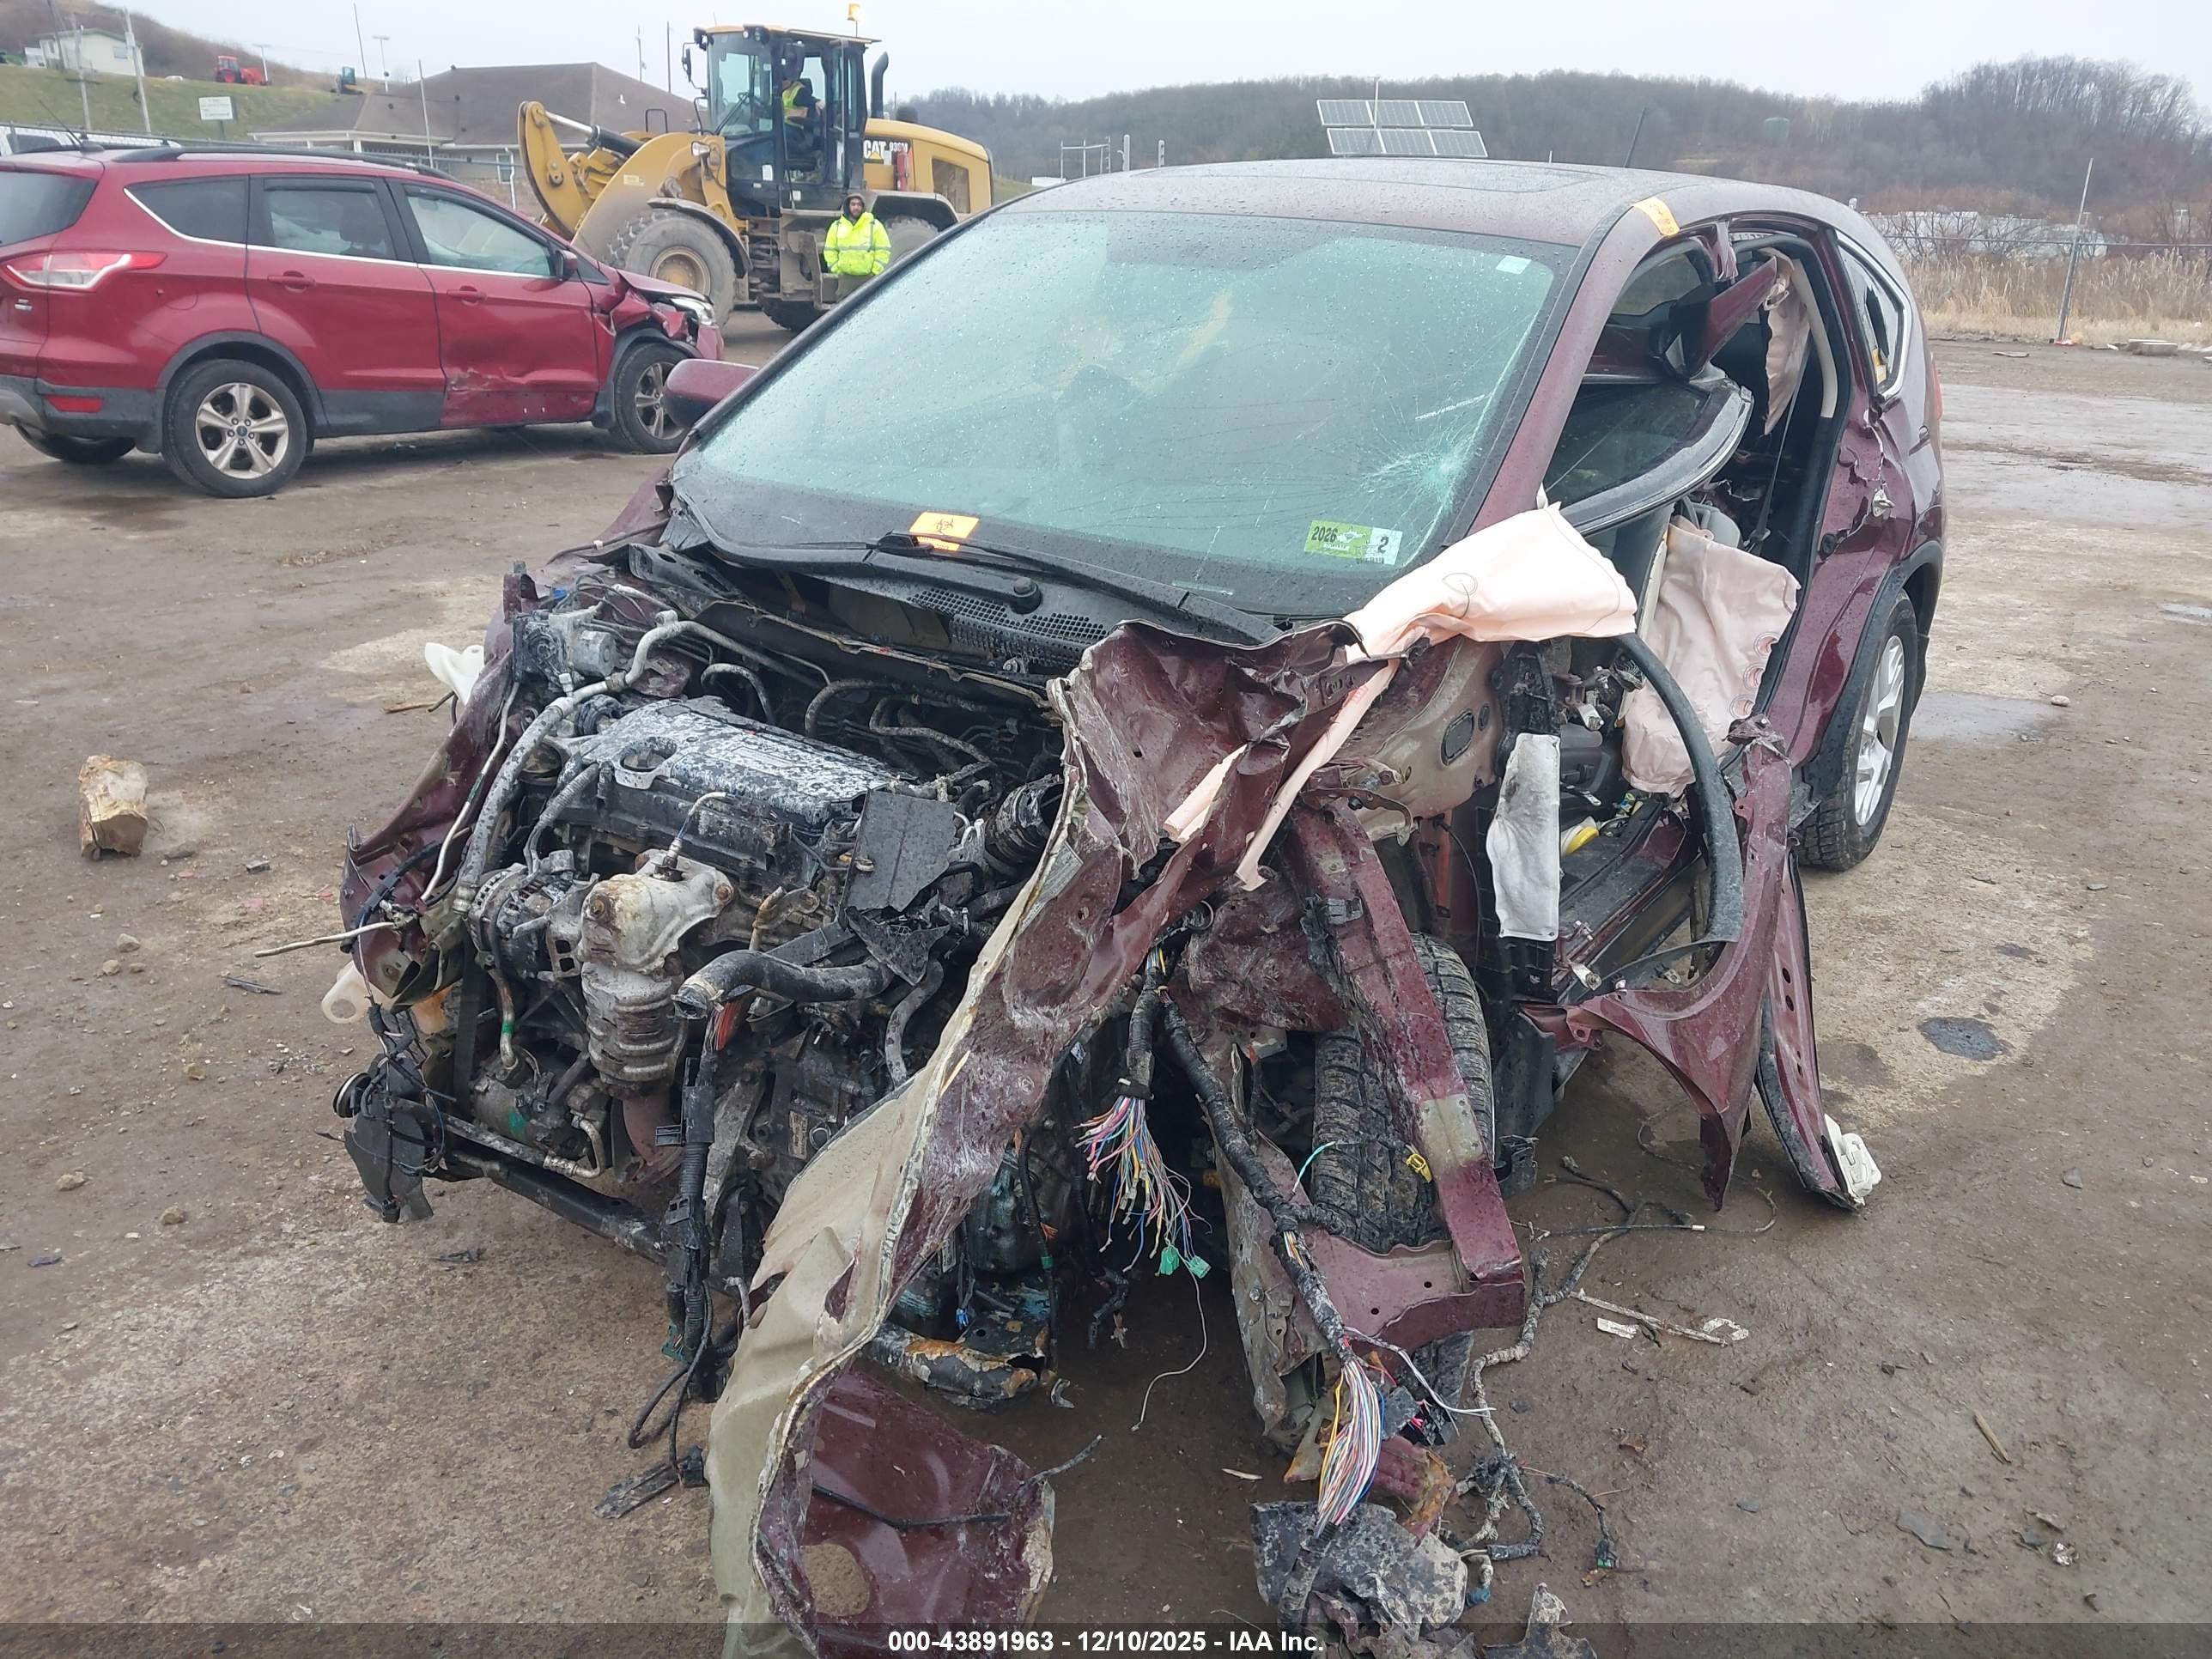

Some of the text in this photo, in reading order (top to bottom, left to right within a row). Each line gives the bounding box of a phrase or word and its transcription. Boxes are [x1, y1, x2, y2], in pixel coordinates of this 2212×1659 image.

[863, 139, 886, 159] CAT
[1311, 526, 1339, 543] 2026
[1377, 536, 1389, 554] 2
